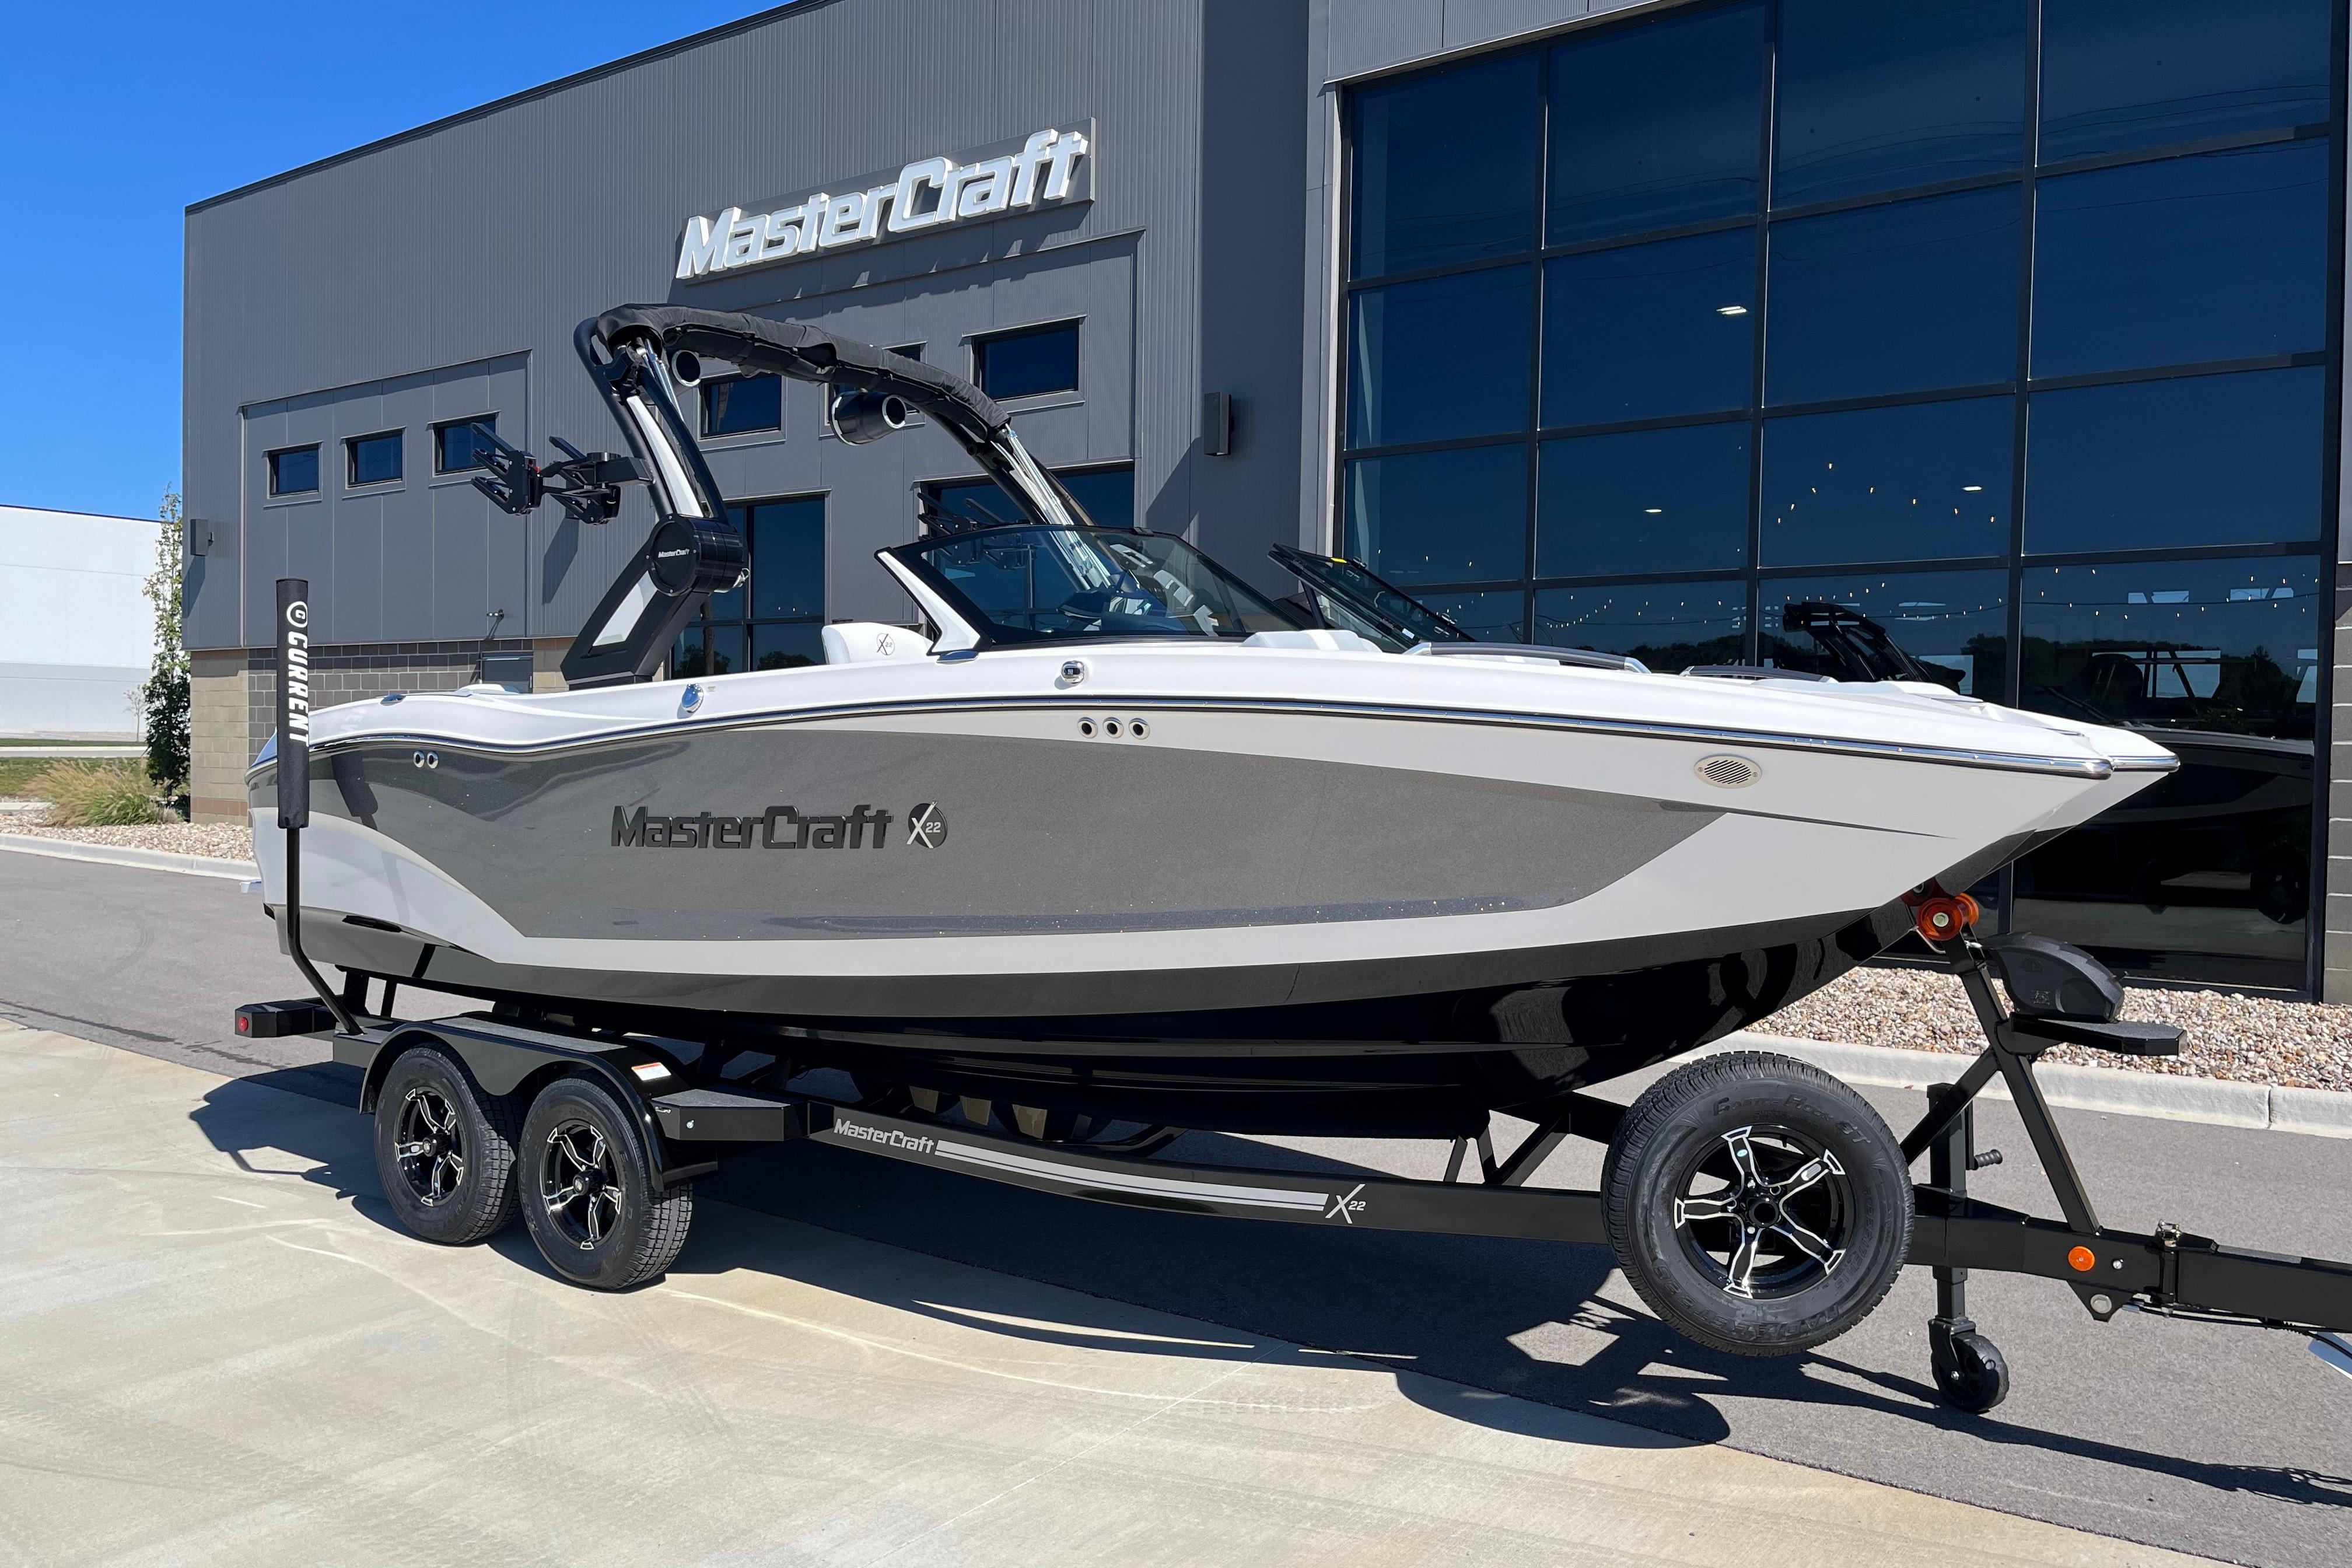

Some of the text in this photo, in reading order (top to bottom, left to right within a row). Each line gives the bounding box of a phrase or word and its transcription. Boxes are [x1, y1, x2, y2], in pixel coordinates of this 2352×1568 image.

[676, 128, 1088, 279] MasterCraft
[288, 631, 309, 747] CURRENT
[611, 801, 941, 849] MasterCraft X22
[834, 1118, 935, 1154] MasterCraft
[1325, 1184, 1366, 1224] X22
